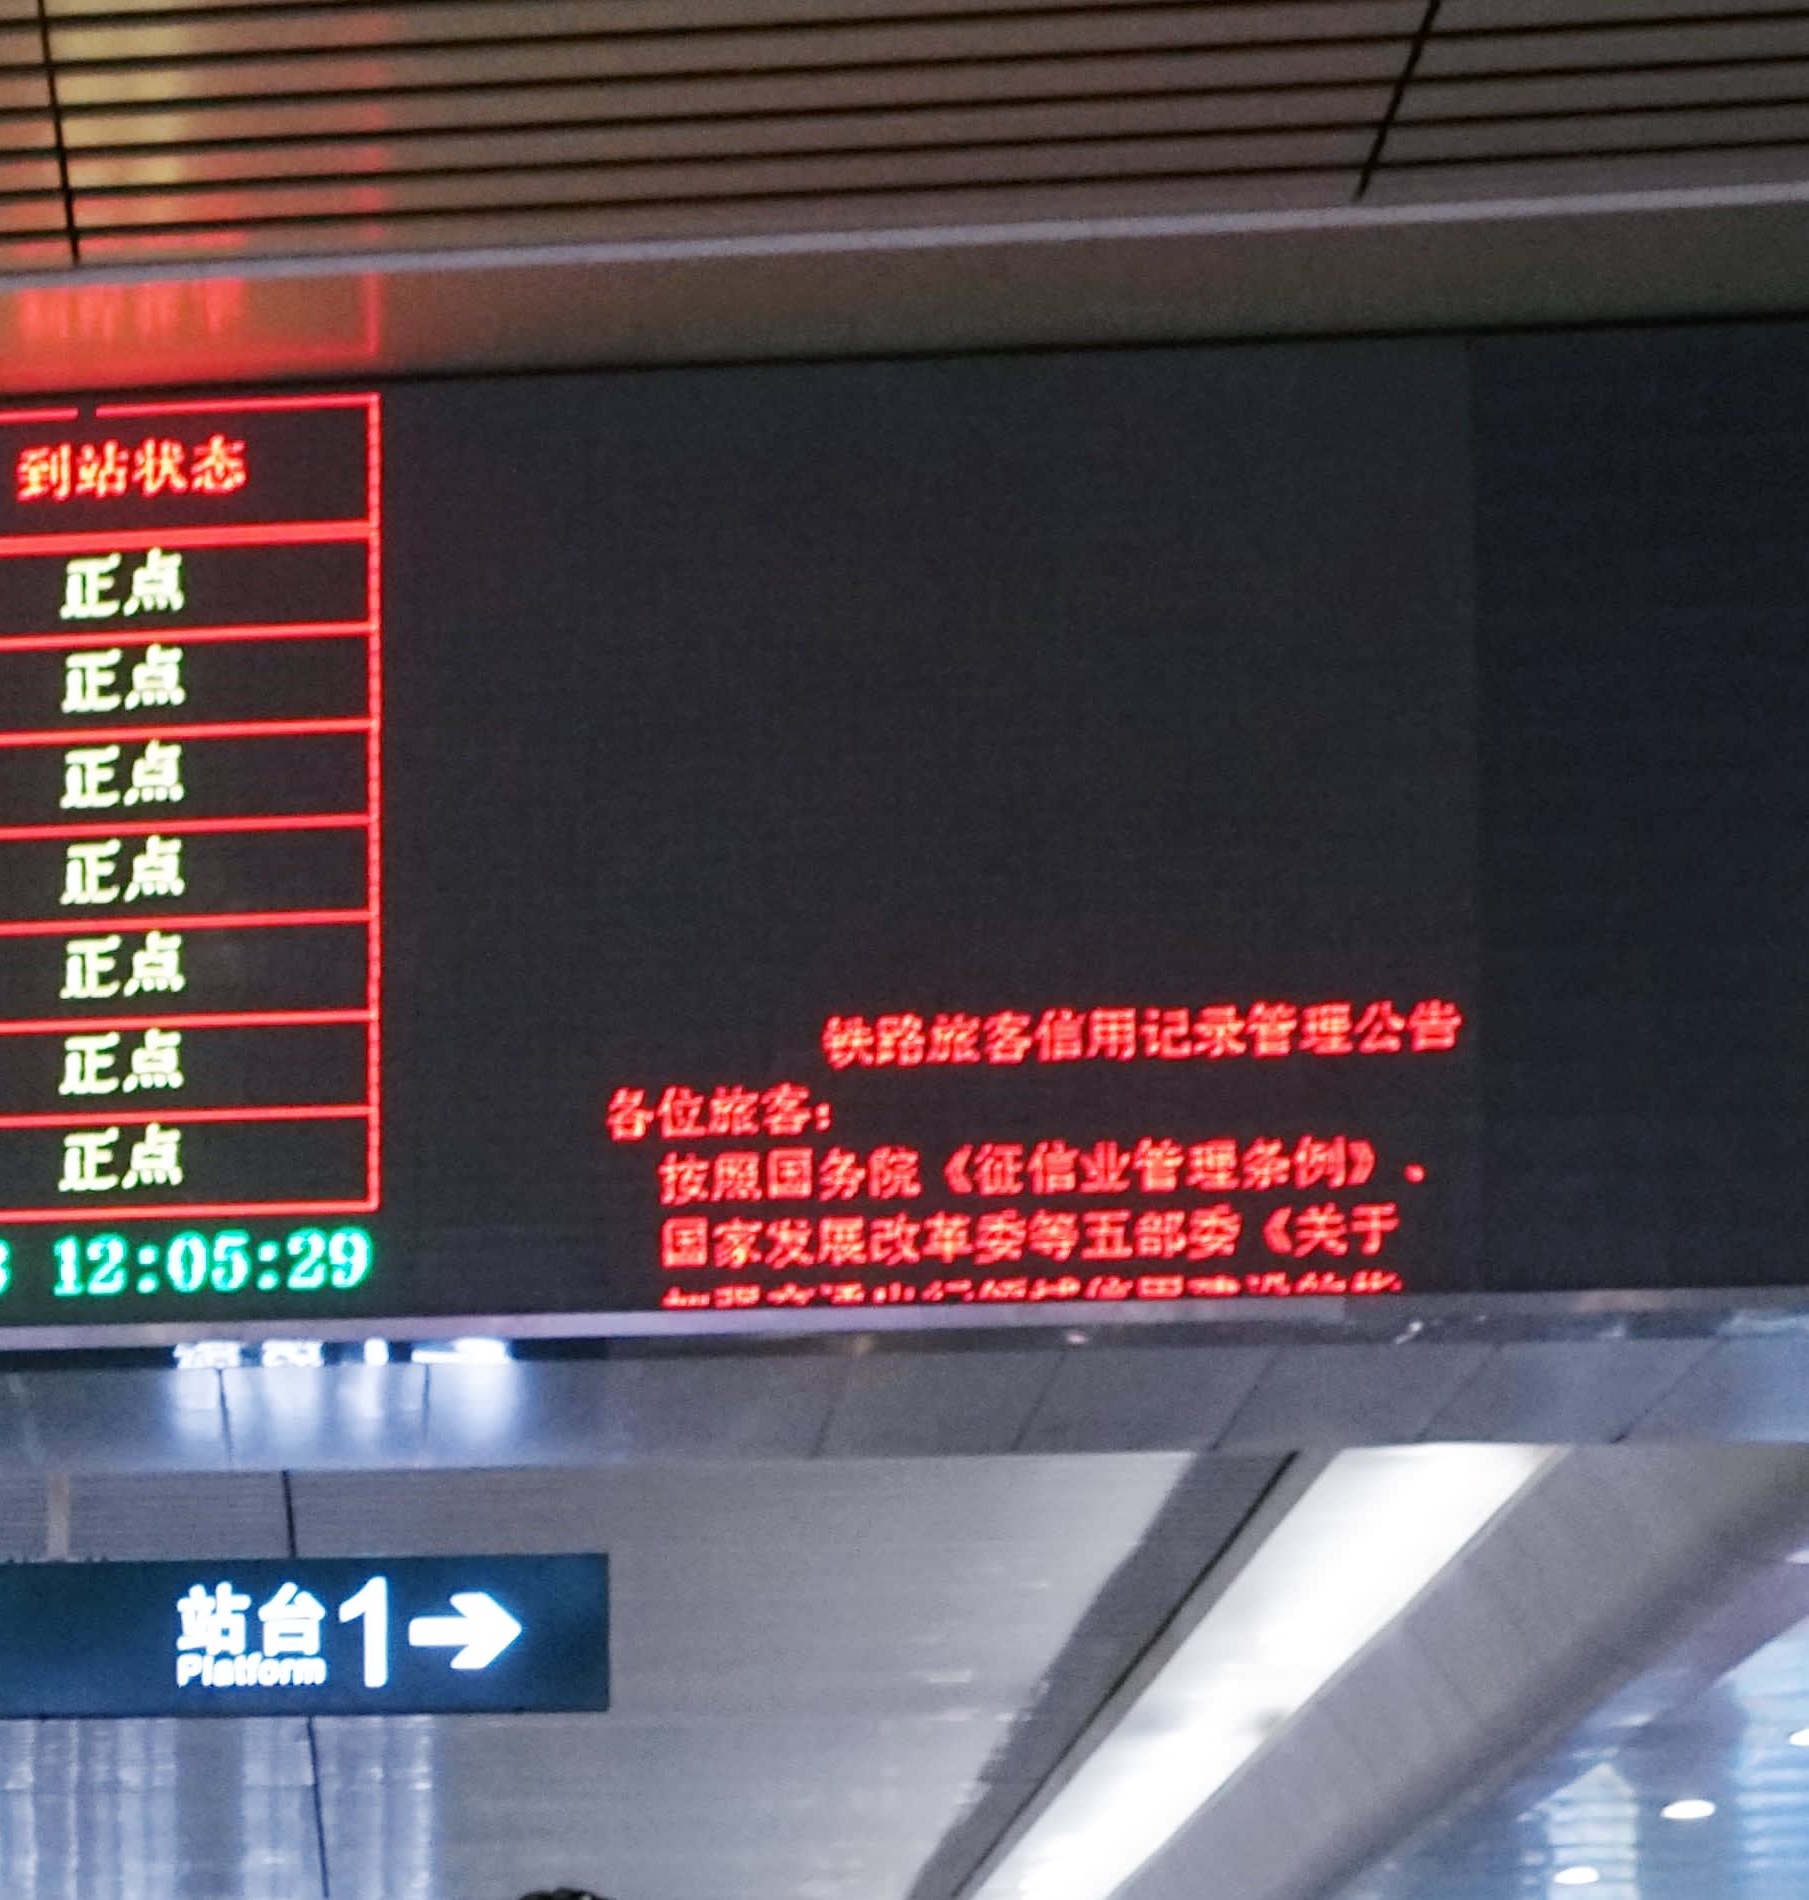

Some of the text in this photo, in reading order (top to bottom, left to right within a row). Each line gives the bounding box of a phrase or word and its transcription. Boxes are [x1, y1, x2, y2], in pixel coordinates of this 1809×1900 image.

[15, 432, 248, 504] 到站状态
[60, 548, 185, 619] 正点
[61, 644, 186, 713] 正点
[60, 740, 185, 809] 正点
[60, 835, 186, 905] 正点
[60, 930, 186, 999] 正点
[58, 1028, 184, 1096] 正点
[822, 1000, 1462, 1069] 铁路旅客信用记录管理公告
[58, 1123, 183, 1192] 正点
[52, 1225, 374, 1297] 12:05:29
[176, 1576, 389, 1688] 站台 1
[176, 1652, 328, 1688] Platform
